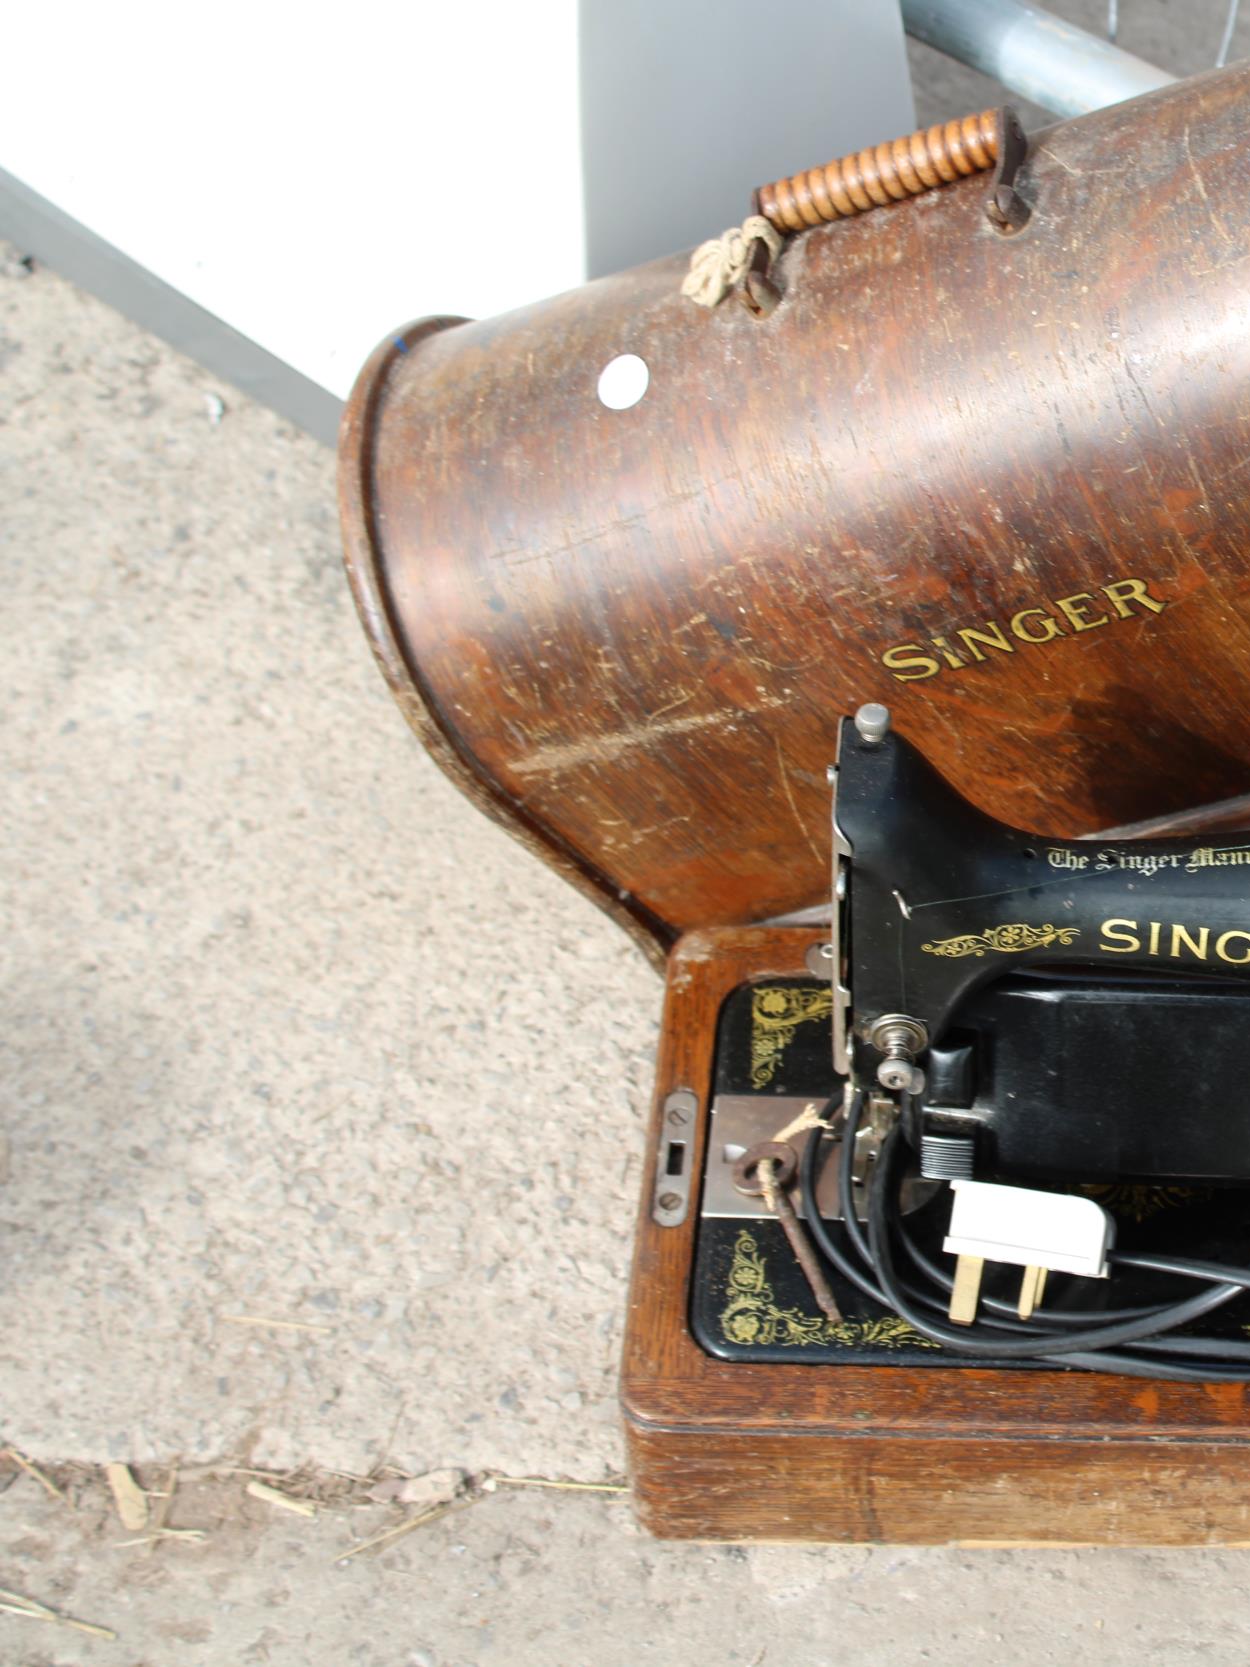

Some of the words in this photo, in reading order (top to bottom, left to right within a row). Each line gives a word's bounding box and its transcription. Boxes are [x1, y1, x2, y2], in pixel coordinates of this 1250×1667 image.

[881, 577, 1167, 683] SINGER
[1046, 846, 1090, 872] The
[1094, 848, 1182, 877] Singer
